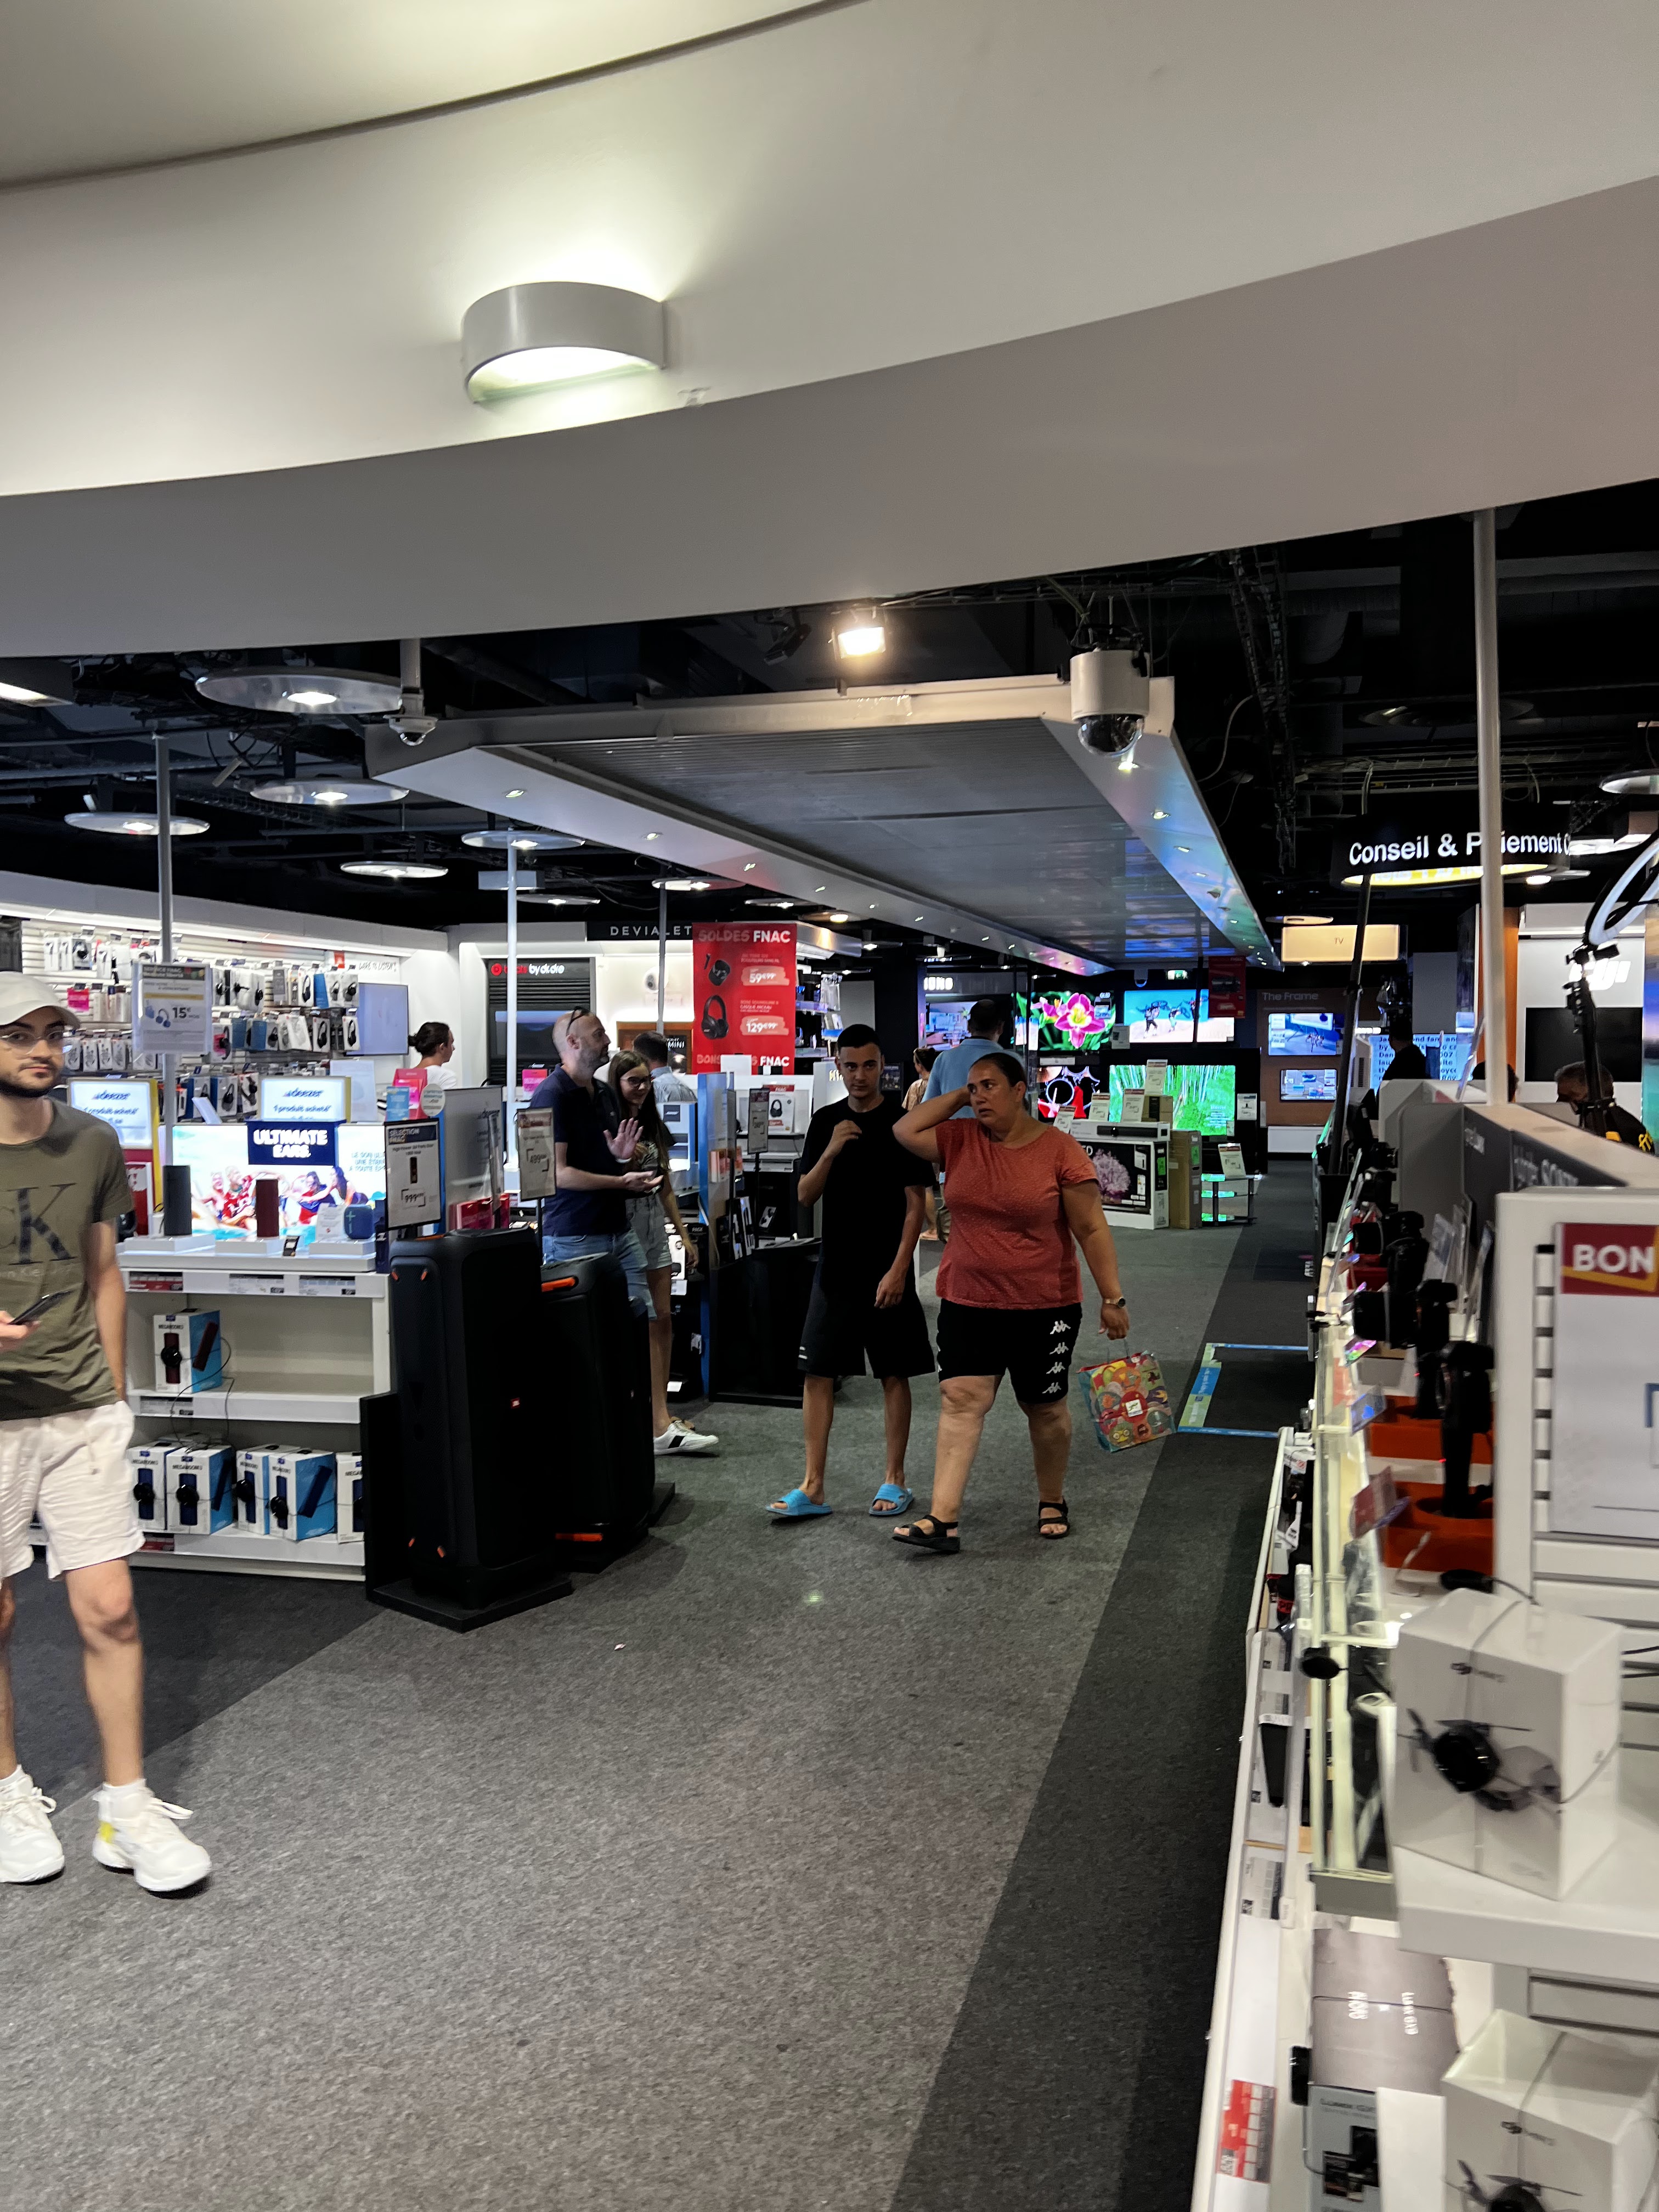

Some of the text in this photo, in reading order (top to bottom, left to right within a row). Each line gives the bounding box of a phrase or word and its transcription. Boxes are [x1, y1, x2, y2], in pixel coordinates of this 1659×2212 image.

[1349, 835, 1429, 866] Conseil
[1437, 833, 1458, 857] &
[1466, 831, 1562, 855] Piement
[698, 930, 791, 943] SOLDES FNAC
[1263, 992, 1319, 1001] The Frame
[760, 1056, 790, 1066] FNAC
[253, 1129, 328, 1146] ULTIMATE
[0, 1182, 78, 1266] K
[1573, 1244, 1655, 1274] BON
